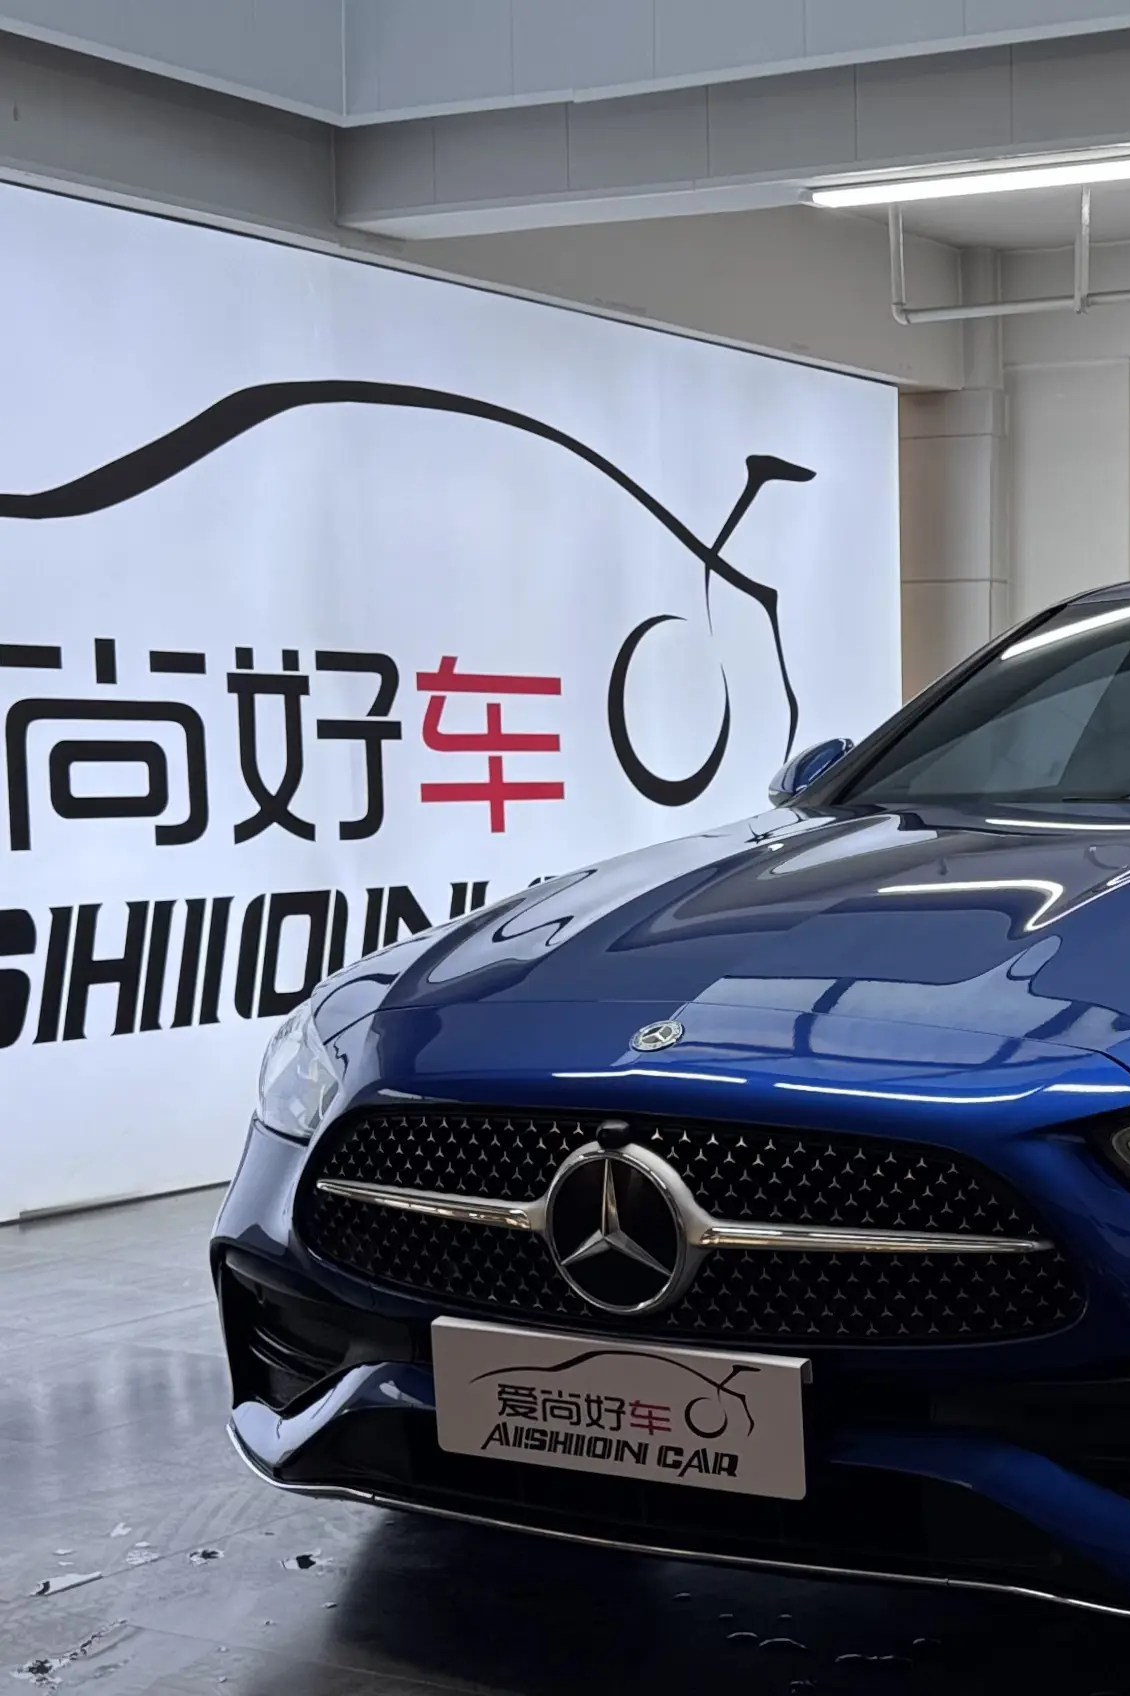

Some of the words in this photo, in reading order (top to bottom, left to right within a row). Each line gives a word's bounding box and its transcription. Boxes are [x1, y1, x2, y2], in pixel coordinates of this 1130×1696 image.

[497, 1382, 672, 1437] 爱尚好车
[480, 1421, 650, 1466] AISHION
[656, 1444, 740, 1478] CAR
